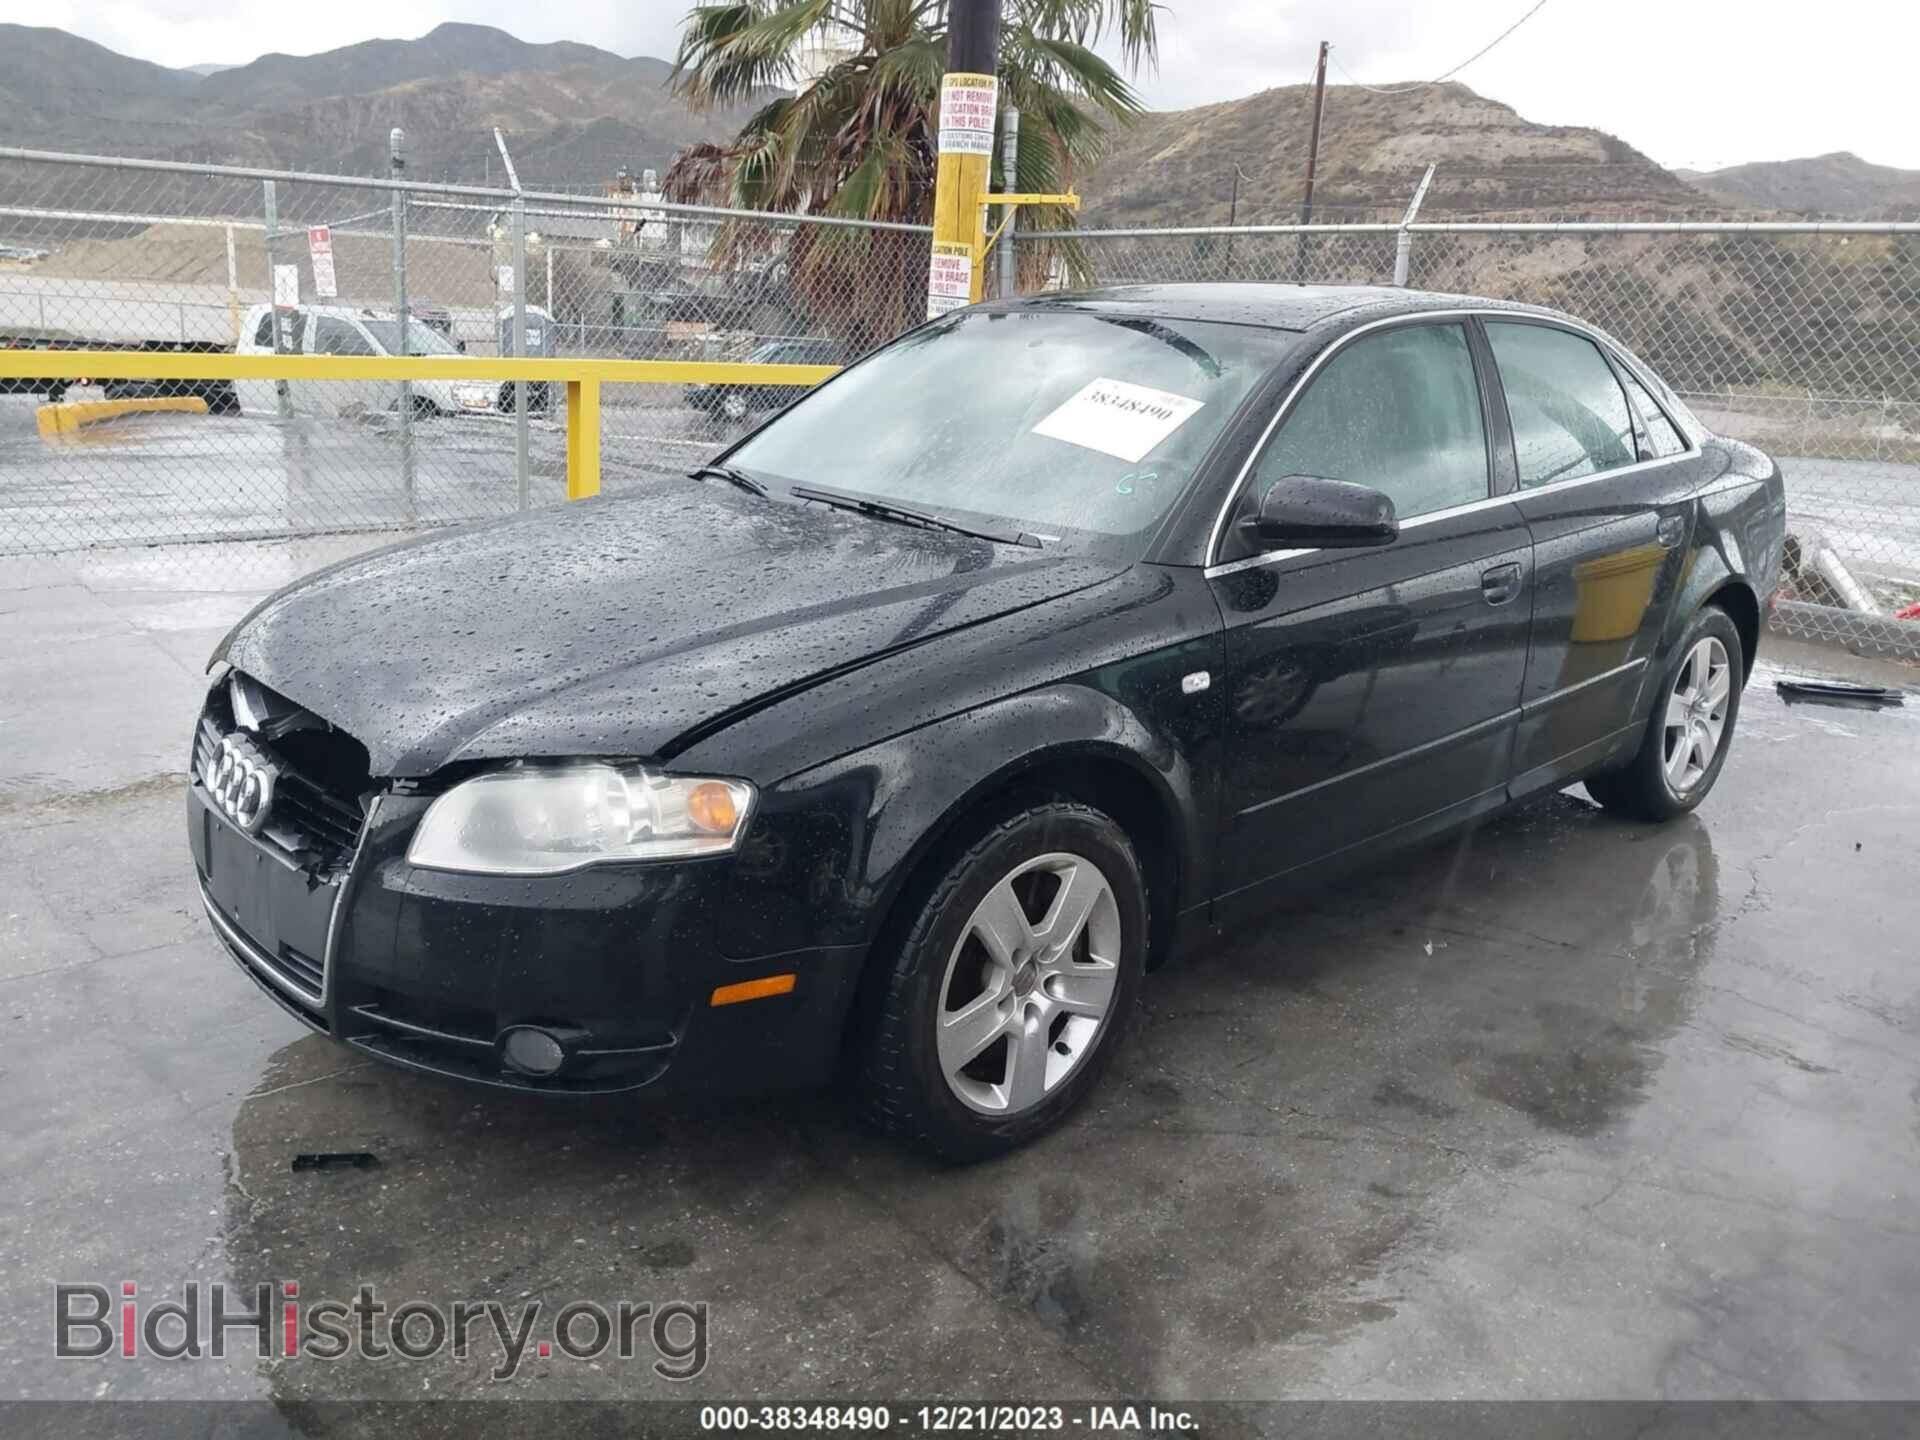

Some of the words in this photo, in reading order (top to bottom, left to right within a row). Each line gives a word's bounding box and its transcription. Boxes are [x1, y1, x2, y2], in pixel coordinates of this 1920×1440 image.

[960, 78, 986, 88] LOCATION
[951, 90, 964, 101] NOT
[951, 116, 966, 127] THIS
[953, 247, 969, 256] POLE
[945, 271, 969, 283] BRACE
